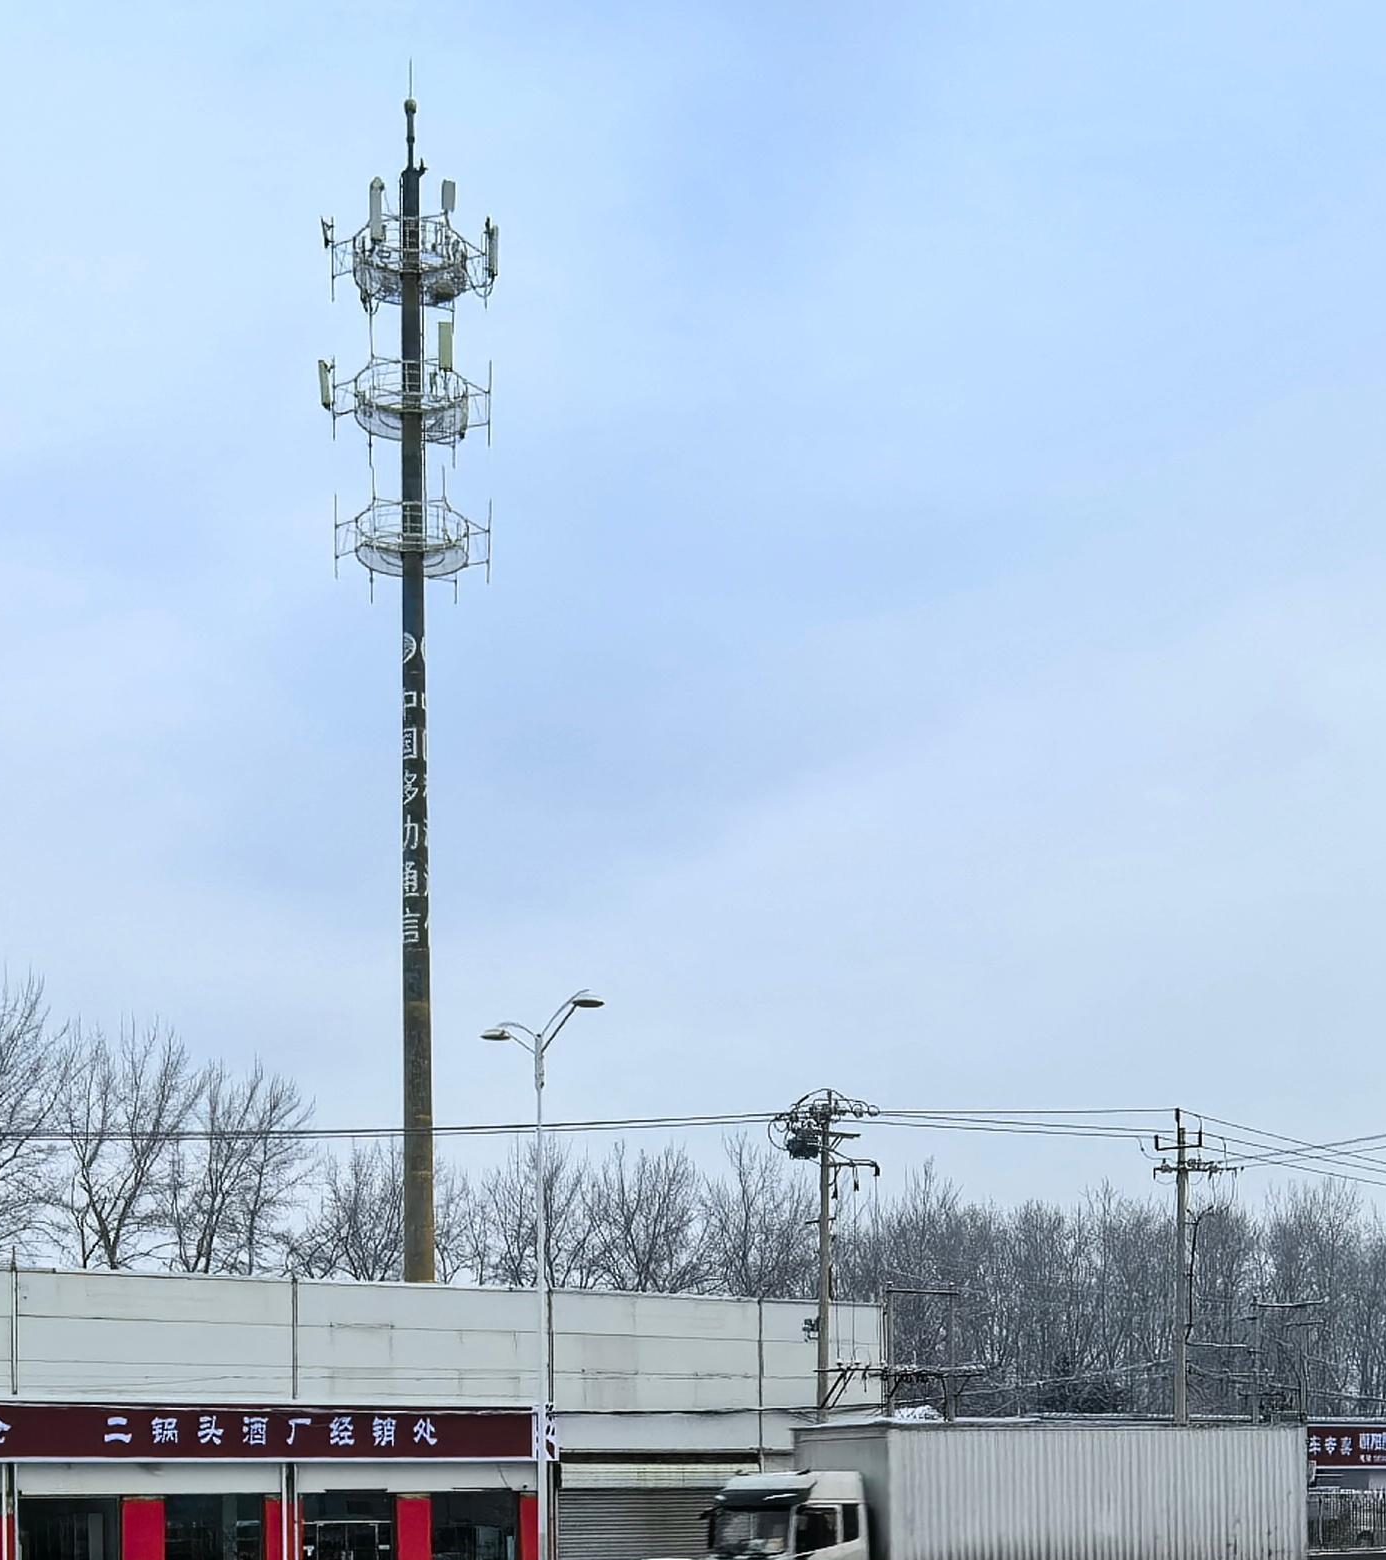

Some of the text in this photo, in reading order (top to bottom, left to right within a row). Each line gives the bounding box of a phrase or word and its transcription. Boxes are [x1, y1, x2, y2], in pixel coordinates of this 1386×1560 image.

[103, 1414, 439, 1447] 二锅头酒厂经销处
